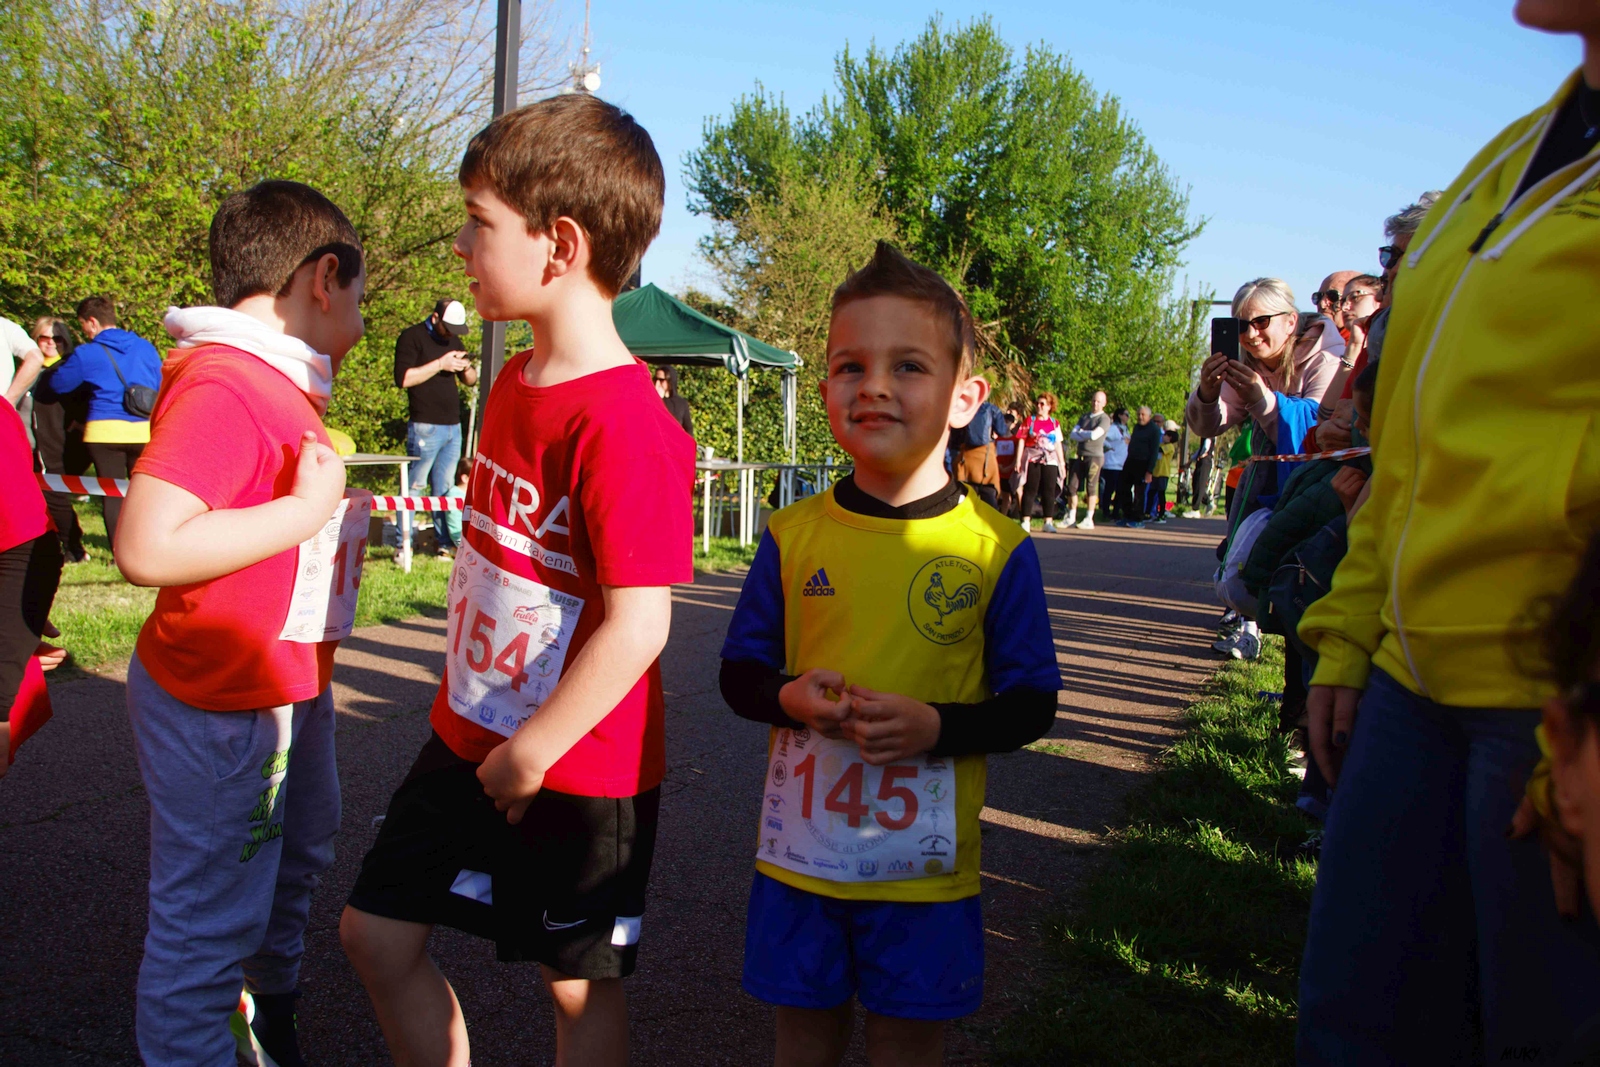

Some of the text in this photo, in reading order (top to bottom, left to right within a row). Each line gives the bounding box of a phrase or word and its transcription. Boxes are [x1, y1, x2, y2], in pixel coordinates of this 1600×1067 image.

[935, 560, 973, 575] ATLETICA
[803, 586, 835, 597] adidas
[554, 594, 580, 608] UISP
[923, 622, 966, 641] SAN PATRIZIO
[453, 596, 531, 693] 154
[793, 753, 919, 831] 145
